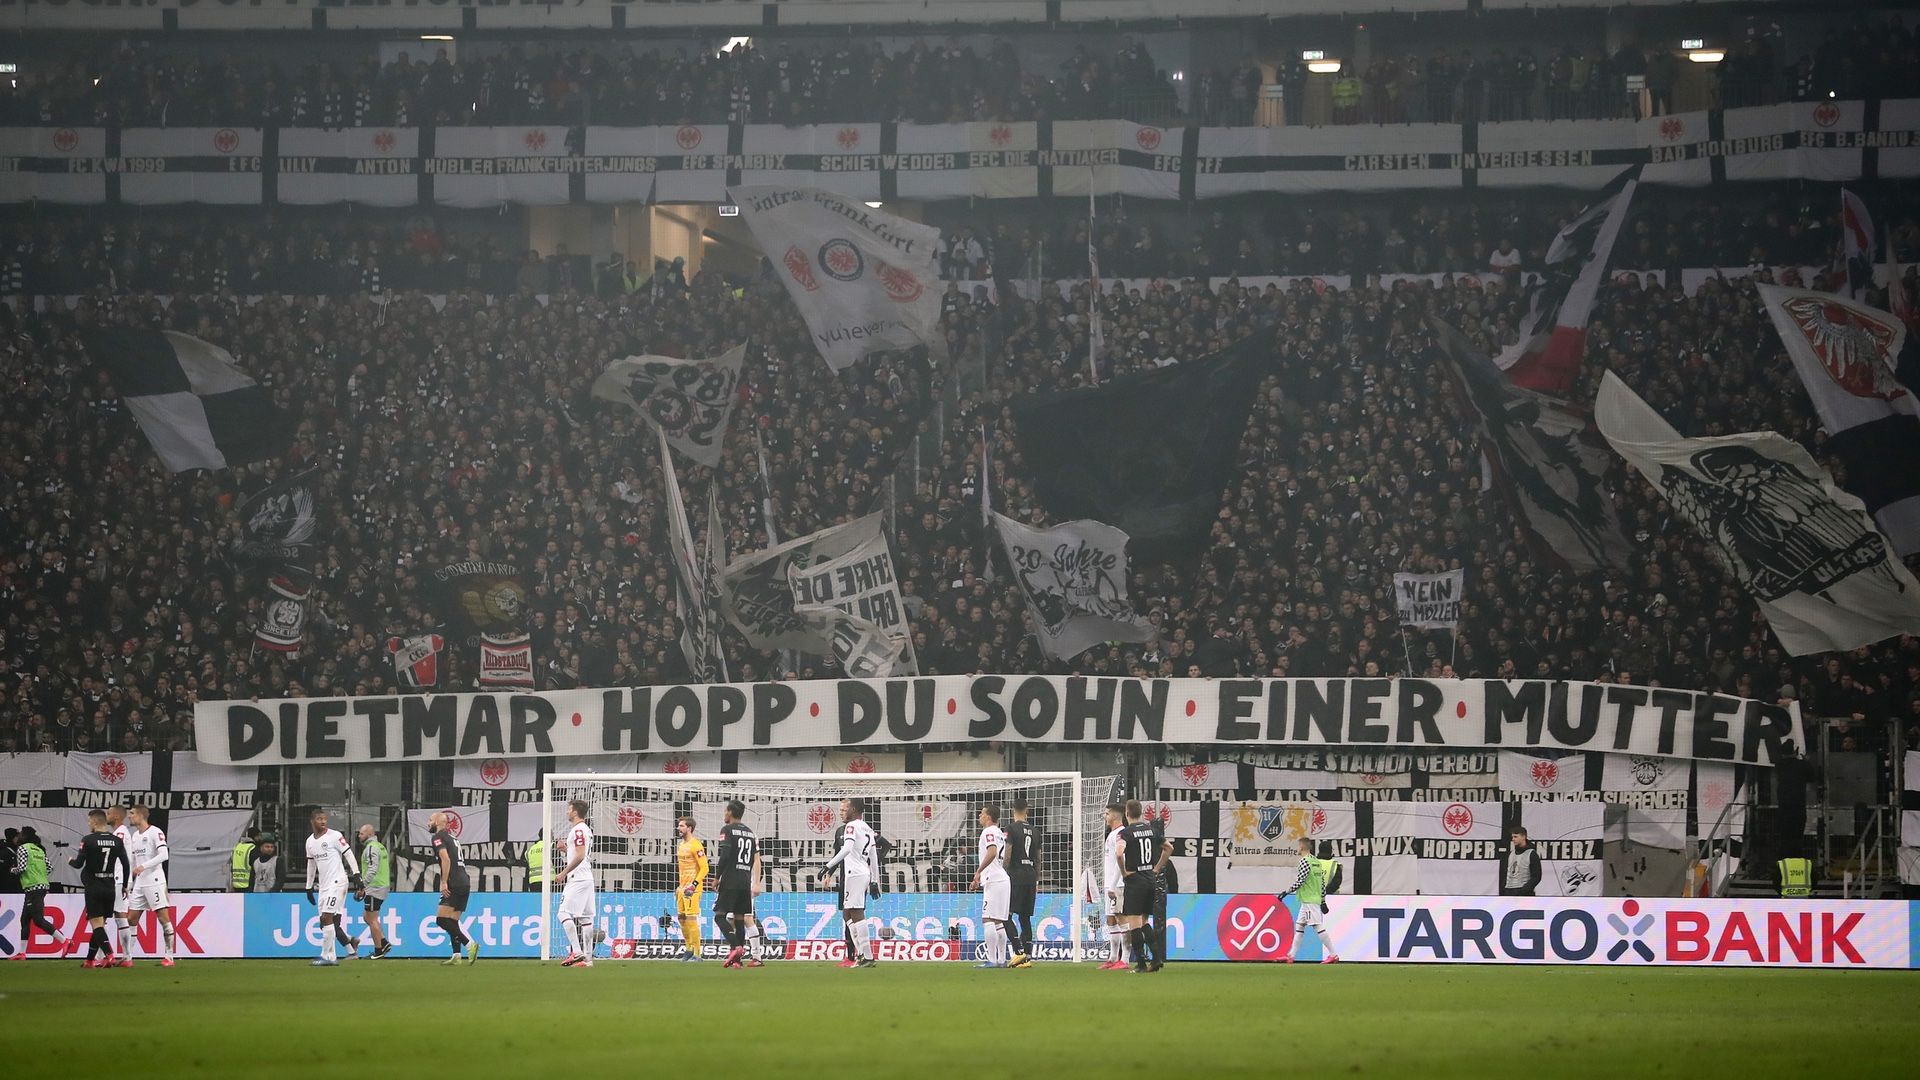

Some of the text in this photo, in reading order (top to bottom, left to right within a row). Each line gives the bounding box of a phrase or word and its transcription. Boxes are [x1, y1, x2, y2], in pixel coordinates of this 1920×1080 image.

[1652, 135, 1784, 163] BAD HOMBURG
[229, 156, 317, 173] EFC LILLY
[355, 157, 411, 174] ANTON
[682, 154, 706, 170] EFC
[820, 154, 955, 172] SCHIETWEDDER
[969, 151, 999, 167] EFC
[1153, 156, 1181, 172] EFC
[1344, 151, 1592, 170] CARSTEN UNVERGESSEN
[1403, 578, 1452, 603] NEIN
[228, 676, 1797, 764] DIETMAR HOPP DU SOHN EINER MUTTER
[67, 789, 172, 809] WINNETOU
[461, 789, 492, 806] THE
[1256, 789, 1319, 802] KAOS
[101, 847, 111, 872] 7
[737, 837, 752, 865] 23
[1139, 838, 1152, 865] 18
[1267, 845, 1301, 857] Mannhe
[326, 896, 337, 907] 18
[418, 908, 542, 947] extra
[1362, 908, 1866, 964] TARGO BANK
[878, 941, 950, 961] ERGO
